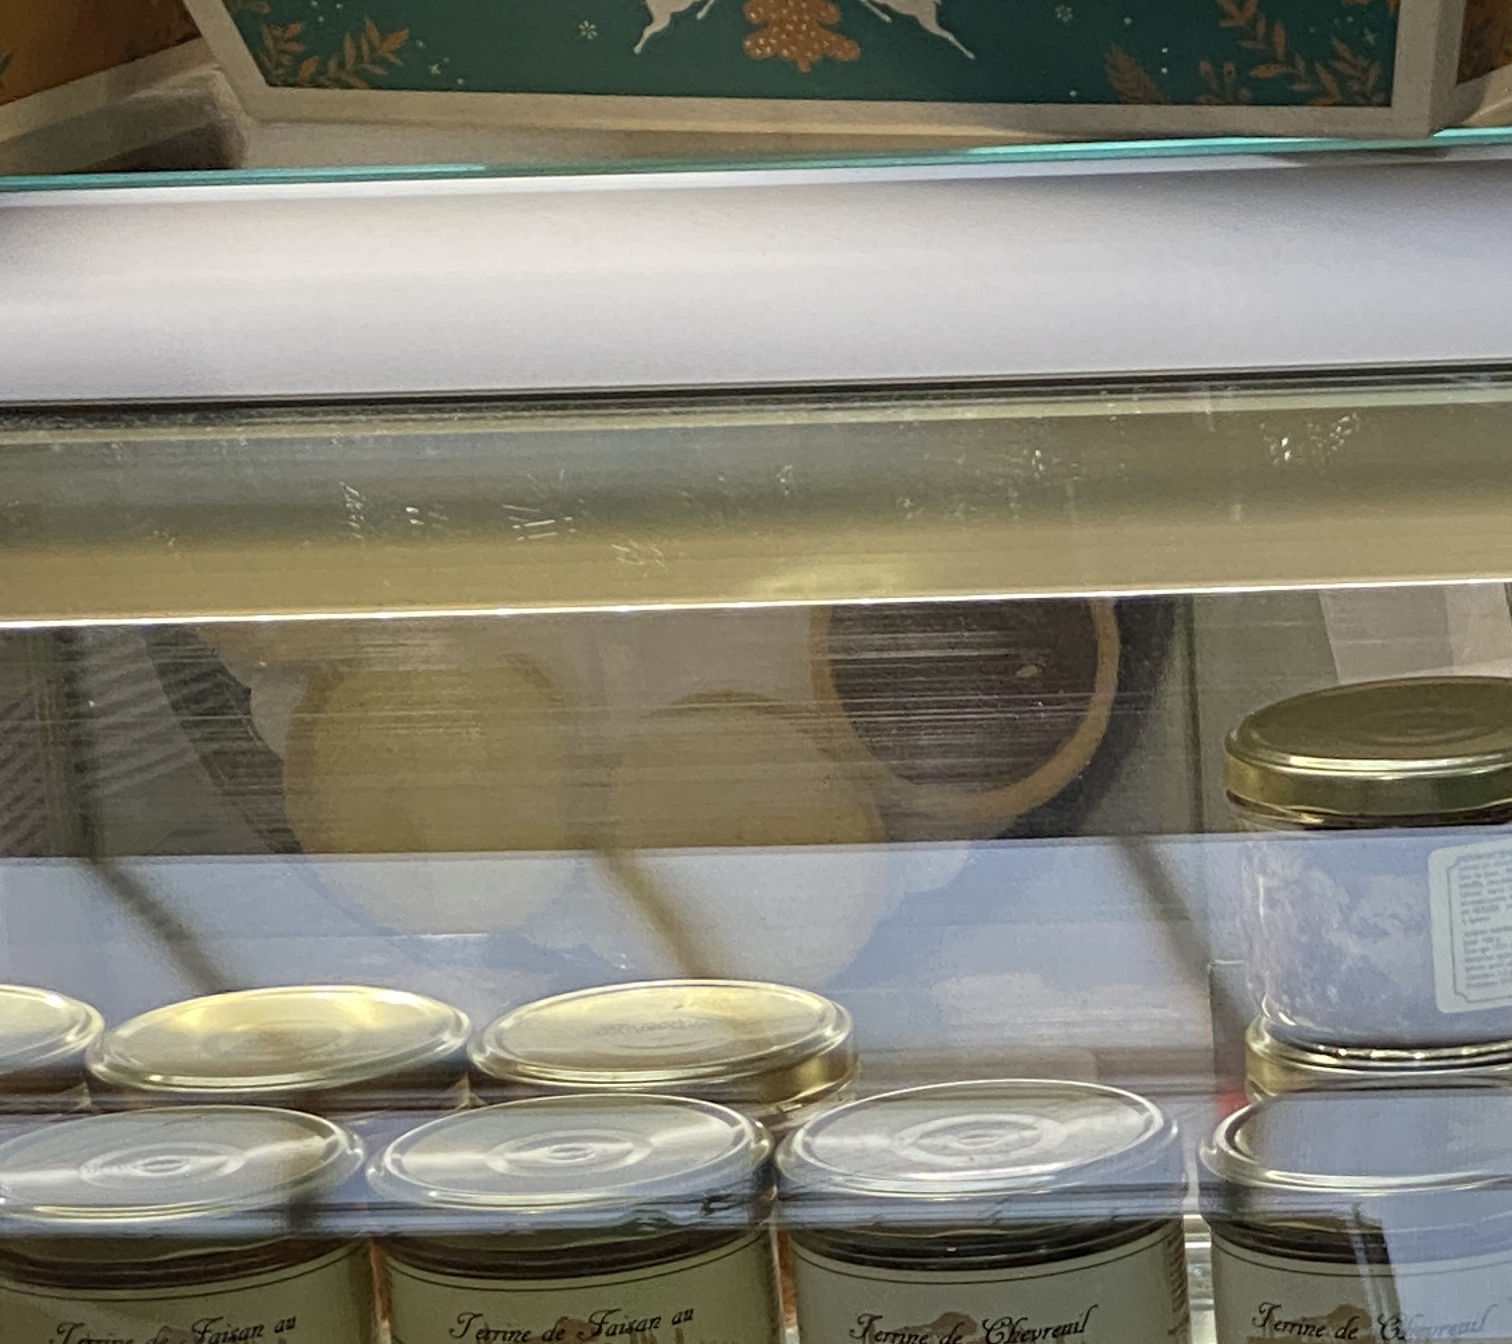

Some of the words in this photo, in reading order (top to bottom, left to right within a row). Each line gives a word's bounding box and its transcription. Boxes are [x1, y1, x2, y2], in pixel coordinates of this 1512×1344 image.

[273, 1315, 297, 1334] au
[450, 1312, 531, 1343] Terrine
[541, 1316, 569, 1342] de
[578, 1308, 662, 1340] Faisan
[671, 1307, 695, 1326] au
[1252, 1301, 1328, 1339] Terrine
[1335, 1315, 1361, 1341] de
